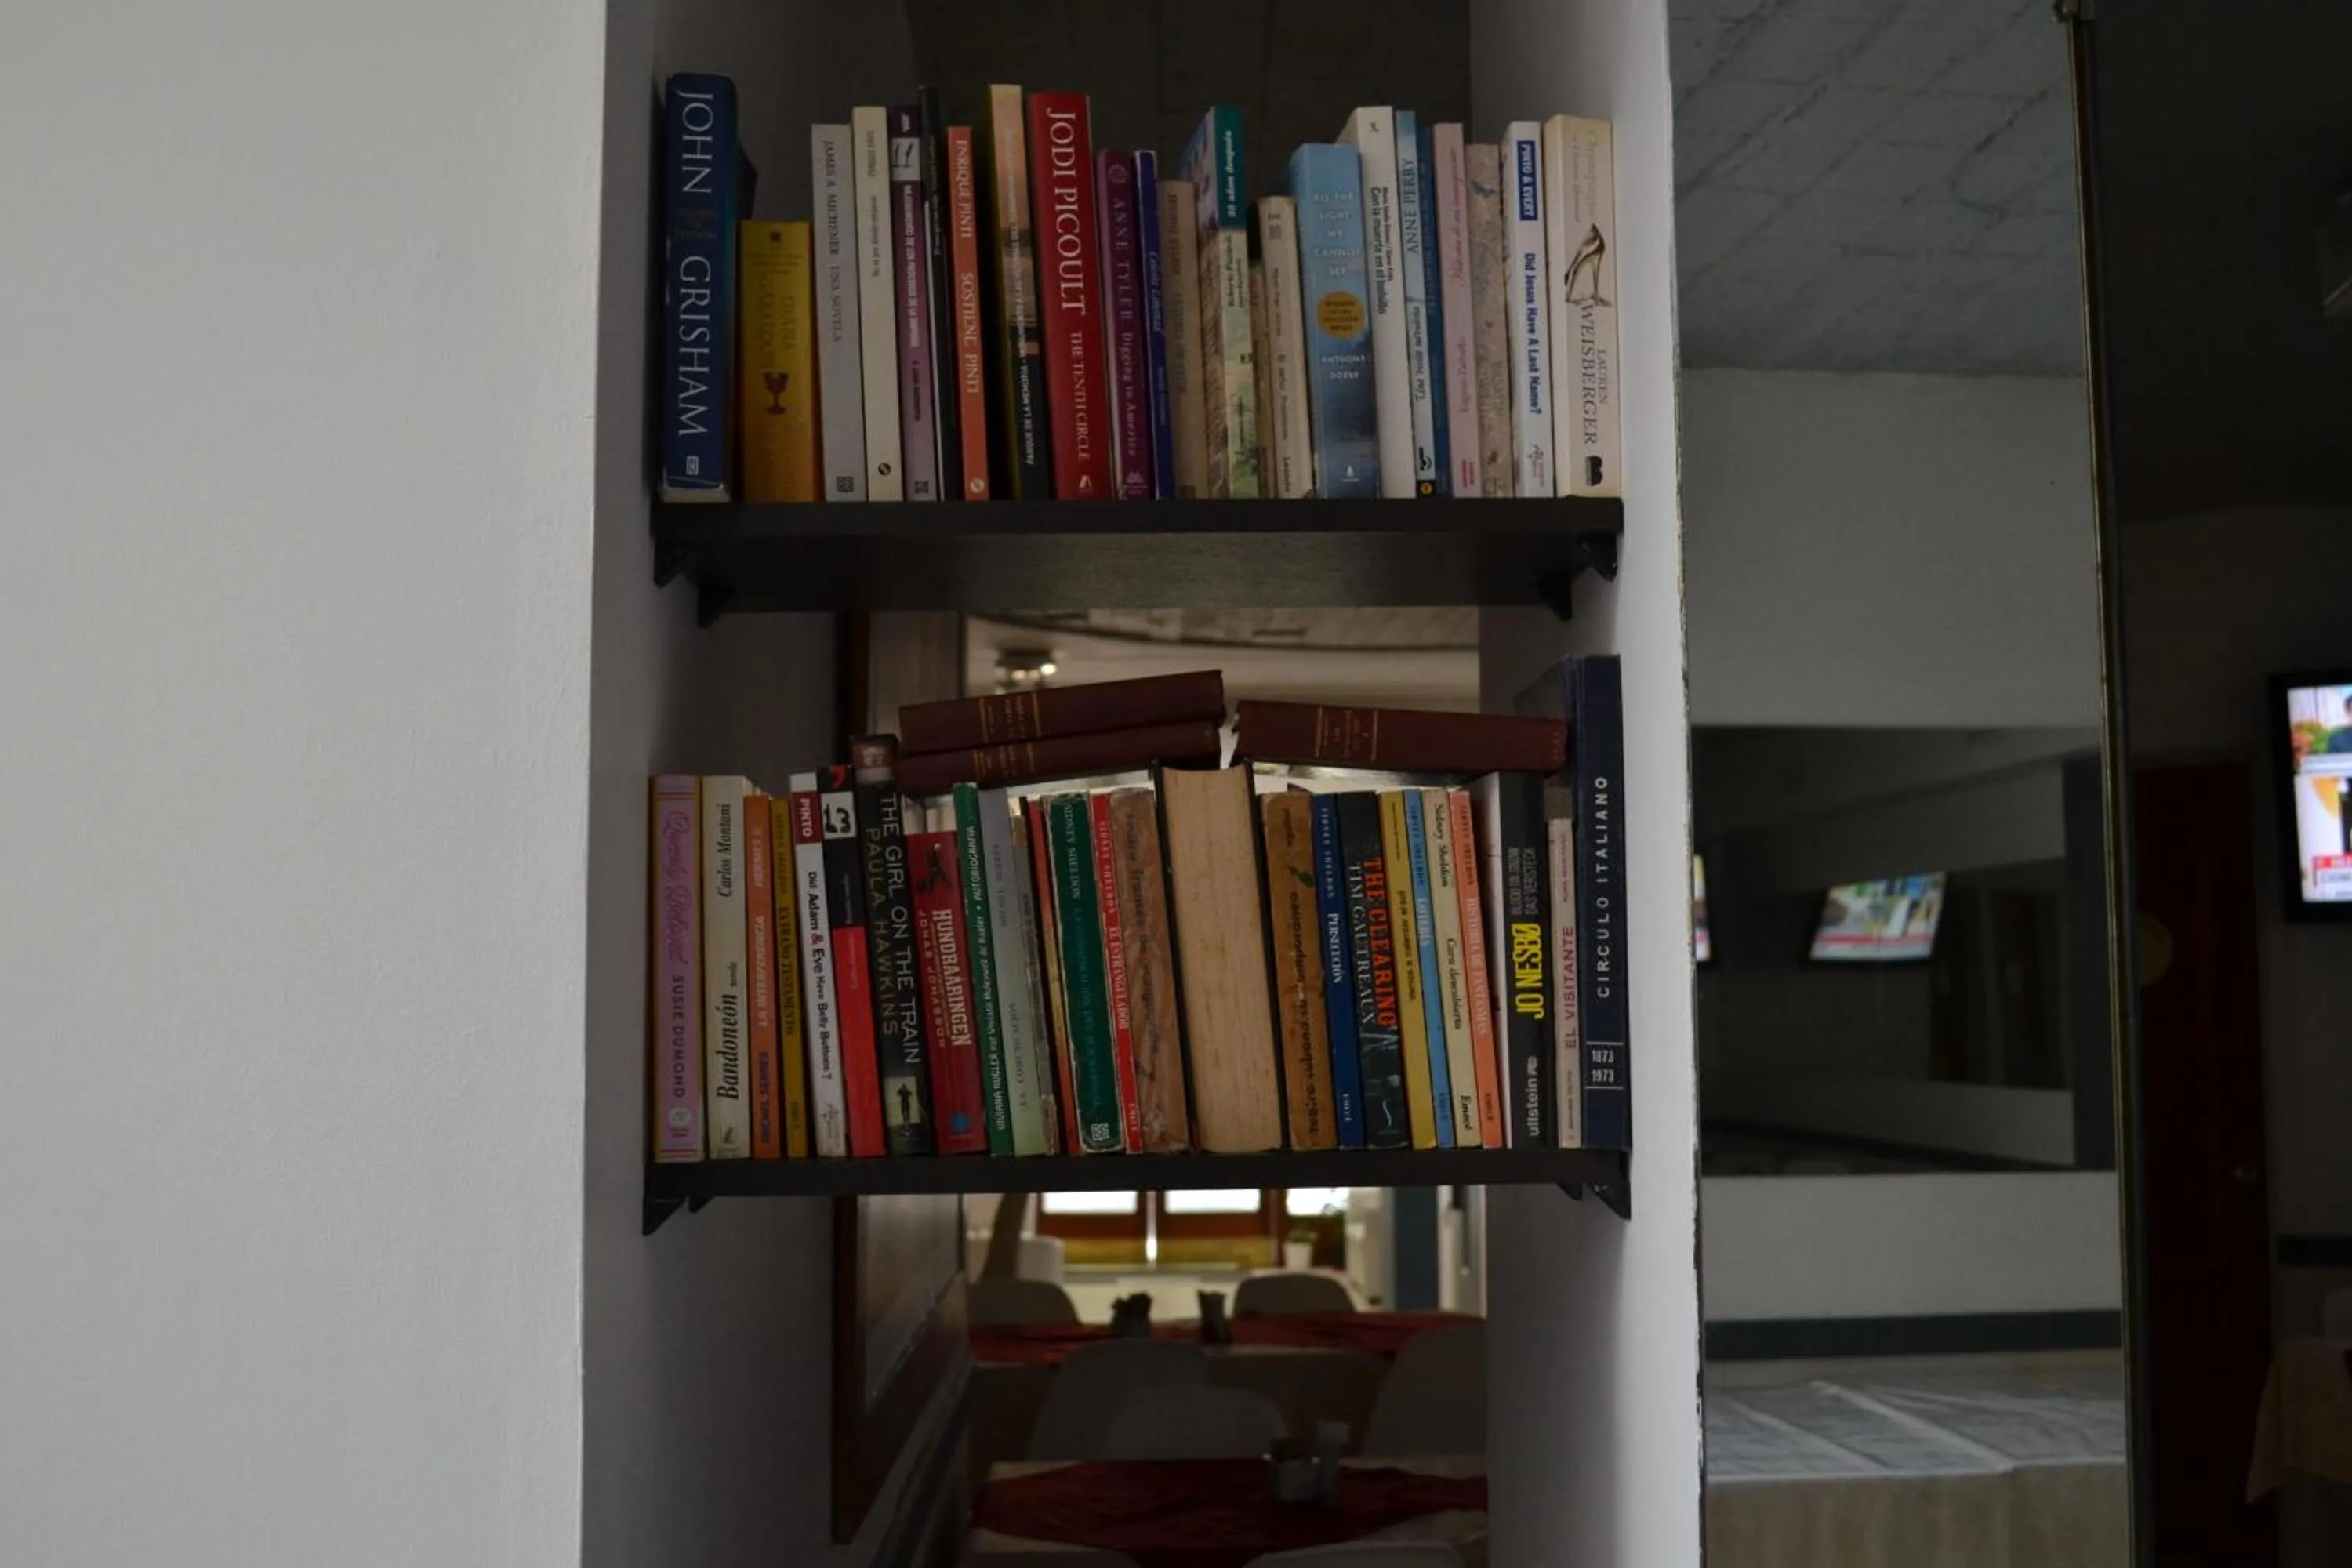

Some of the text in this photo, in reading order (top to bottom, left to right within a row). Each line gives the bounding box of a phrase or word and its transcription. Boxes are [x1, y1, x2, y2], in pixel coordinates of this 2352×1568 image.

[677, 91, 714, 194] JOHN
[1519, 143, 1532, 174] PINTO
[824, 141, 840, 256] JAMES MICHENER
[956, 140, 973, 238] ENRIQUE PINTI
[1047, 107, 1086, 316] JODI PICOULT
[1319, 210, 1352, 221] LIGHT
[1371, 187, 1384, 206] Con
[1373, 208, 1384, 216] la
[1401, 158, 1419, 255] ANNE PERRY
[1521, 187, 1534, 217] EVERT
[1114, 198, 1134, 321] ANNE TYLER
[1373, 218, 1385, 253] muerte
[1375, 256, 1385, 268] en
[831, 294, 843, 343] NOVELA
[960, 272, 980, 394] SOSTIENE PINTI
[1377, 280, 1388, 314] bolsillo
[677, 256, 710, 437] GRISHAM
[1523, 252, 1542, 415] Did Jesus Have A Last Name?
[1069, 332, 1090, 463] THE TENTH CIRCLE
[1579, 304, 1598, 445] WEISBERGER
[1595, 349, 1608, 405] LAUREN
[799, 798, 816, 837] PINTO
[1064, 804, 1082, 901] SIDNEY SHELDON
[1433, 804, 1452, 887] Sidney Sheldon
[663, 811, 692, 964] Queerly Beloved
[717, 858, 733, 898] Carlos
[808, 872, 818, 888] Did
[1098, 820, 1115, 914] SIDNEY SHELDON
[1594, 776, 1611, 998] CIRCULO ITALIANO
[779, 906, 793, 959] EXTRAÑO
[808, 893, 821, 931] Adam
[811, 933, 824, 945] &
[866, 827, 899, 1035] PAULA HAWKINS
[880, 793, 922, 1062] THE GIRL ON THE TRAIN
[1348, 862, 1376, 1024] TIM GAUTREAUX
[1363, 856, 1398, 1028] THE CLEARING
[1468, 898, 1482, 951] HISTORIA
[812, 948, 826, 973] Eve
[919, 909, 932, 959] JONAS
[926, 967, 946, 1048] JONASSON
[1110, 939, 1130, 1029] ESTRANGULADOR
[1327, 912, 1345, 985] PERSECUCIÓN
[1446, 938, 1460, 965] Cara
[1511, 922, 1545, 1019] JO NESBØ
[782, 964, 796, 1036] TESTAMENTO
[816, 976, 826, 1000] Have
[817, 1004, 829, 1029] Belly
[1472, 971, 1487, 1036] FANTASMAS
[1563, 926, 1577, 1049] EL VISITANTE
[672, 975, 686, 1098] SUSIE DUMOND
[715, 993, 739, 1101] Bandoneón
[819, 1031, 831, 1072] Buttons
[1592, 1051, 1614, 1064] 1873
[1525, 1078, 1540, 1136] ullstein
[1592, 1069, 1614, 1083] 1973
